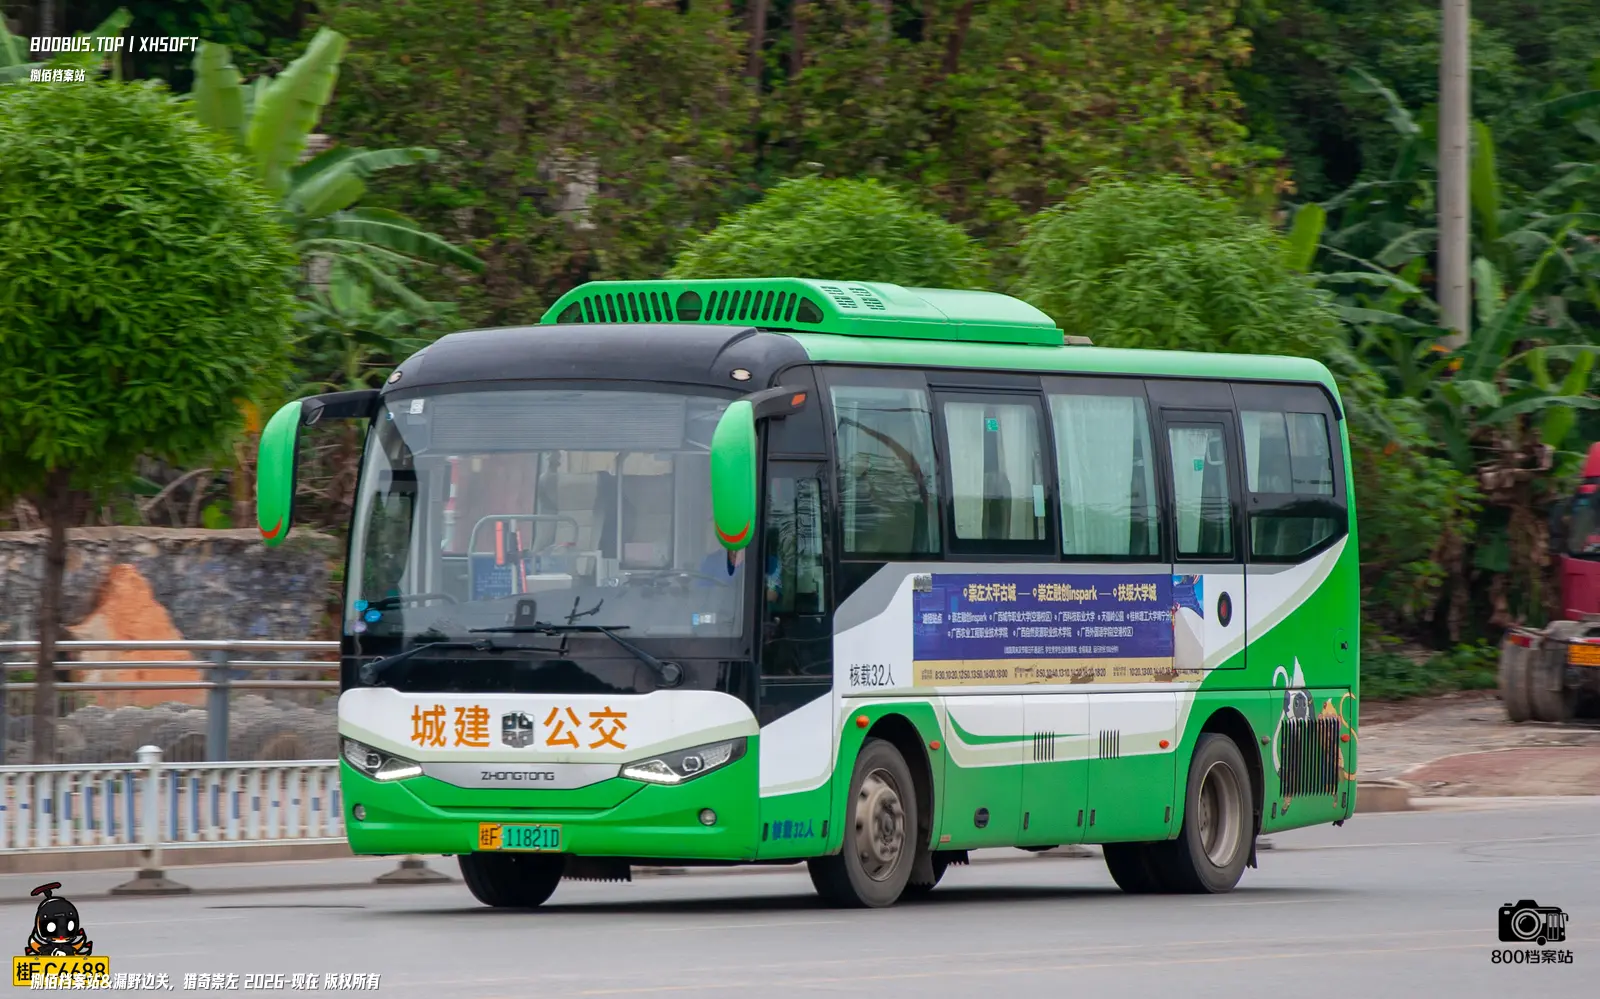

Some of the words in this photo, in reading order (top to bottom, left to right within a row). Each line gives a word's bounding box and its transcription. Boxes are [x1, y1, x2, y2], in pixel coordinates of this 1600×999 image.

[968, 583, 1017, 602] 崇左太平古城
[849, 664, 895, 686] 核载32人
[411, 704, 491, 749] 城建
[543, 706, 628, 750] 公交
[481, 771, 555, 781] ZHONGTONG
